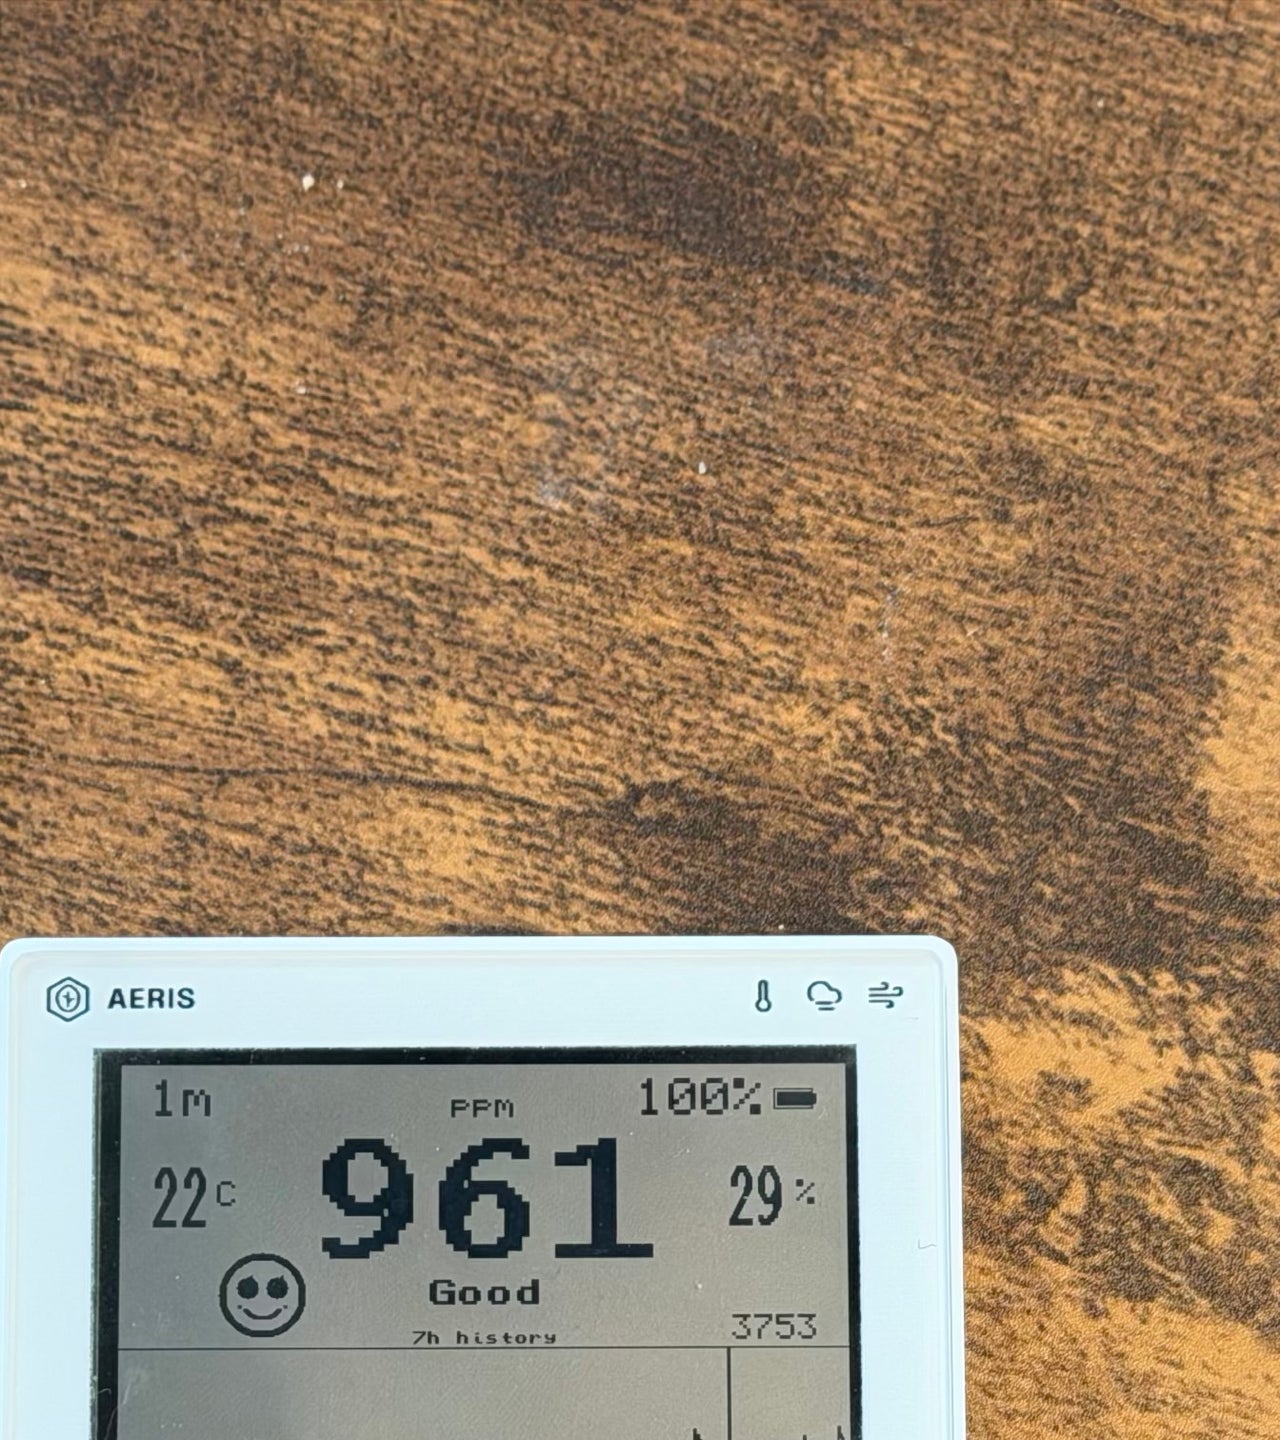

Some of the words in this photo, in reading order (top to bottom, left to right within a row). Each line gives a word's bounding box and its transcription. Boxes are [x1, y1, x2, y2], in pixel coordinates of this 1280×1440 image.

[107, 987, 195, 1009] AERIS
[155, 1079, 211, 1117] 1m
[450, 1099, 514, 1118] PPM
[640, 1077, 761, 1116] 100%
[321, 1137, 654, 1260] 961
[429, 1278, 540, 1306] Good
[412, 1330, 440, 1345] 7h
[456, 1330, 556, 1345] history
[731, 1313, 817, 1340] 3753
